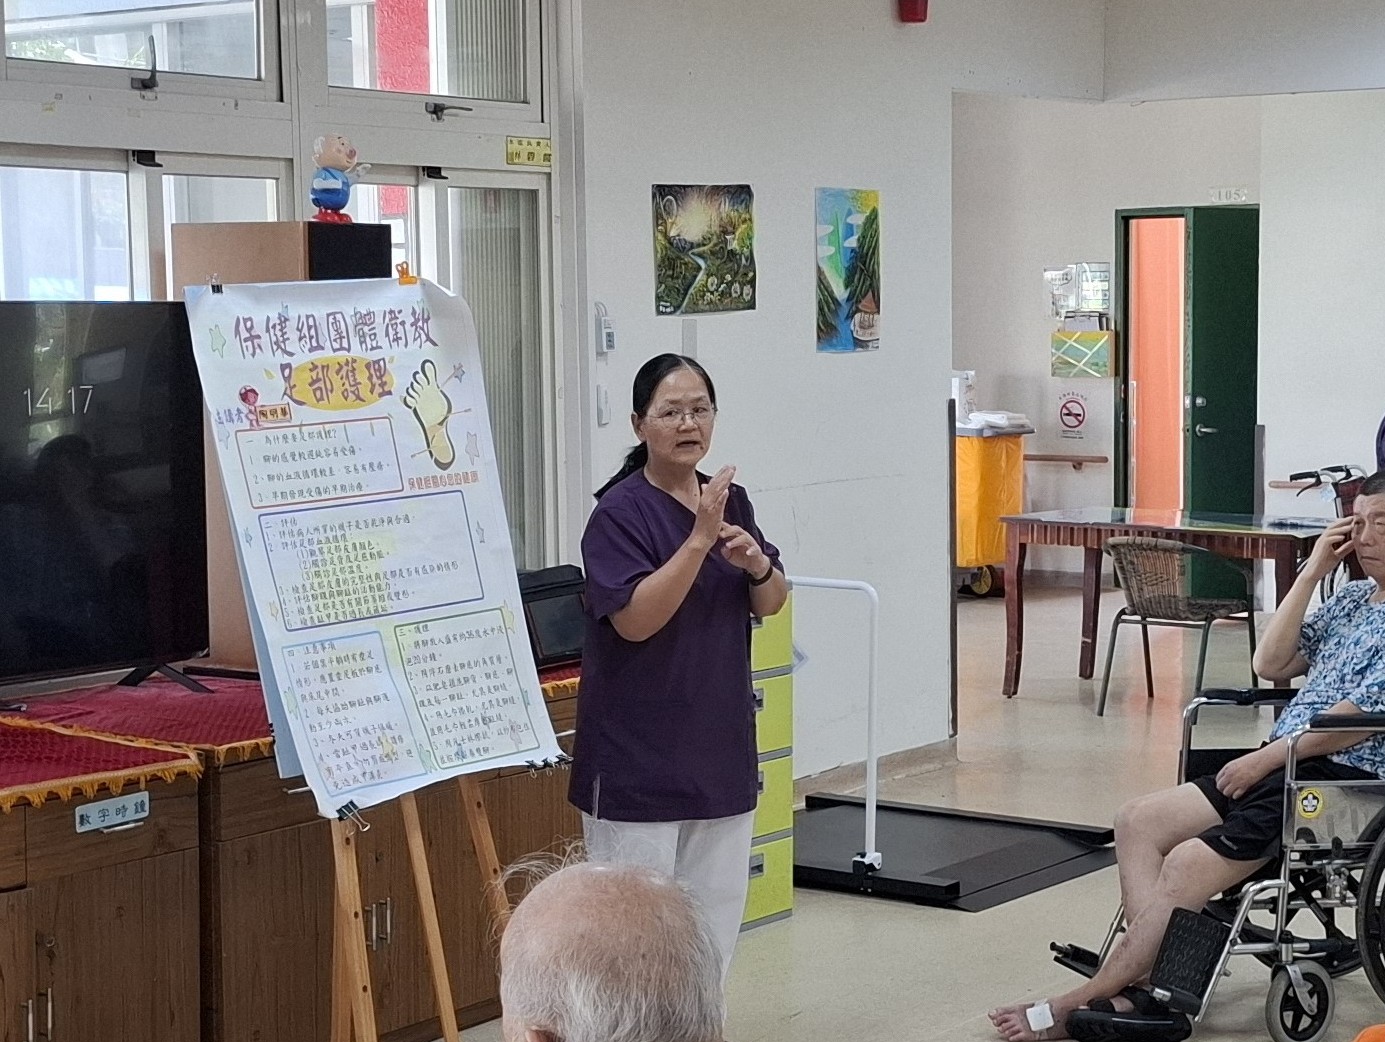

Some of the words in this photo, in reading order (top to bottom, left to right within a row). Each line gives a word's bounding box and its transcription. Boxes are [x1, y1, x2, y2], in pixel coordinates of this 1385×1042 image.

[234, 305, 439, 359] 保健組團體衛教
[280, 357, 393, 406] 足部護理
[79, 799, 147, 827] 數字時鐘
